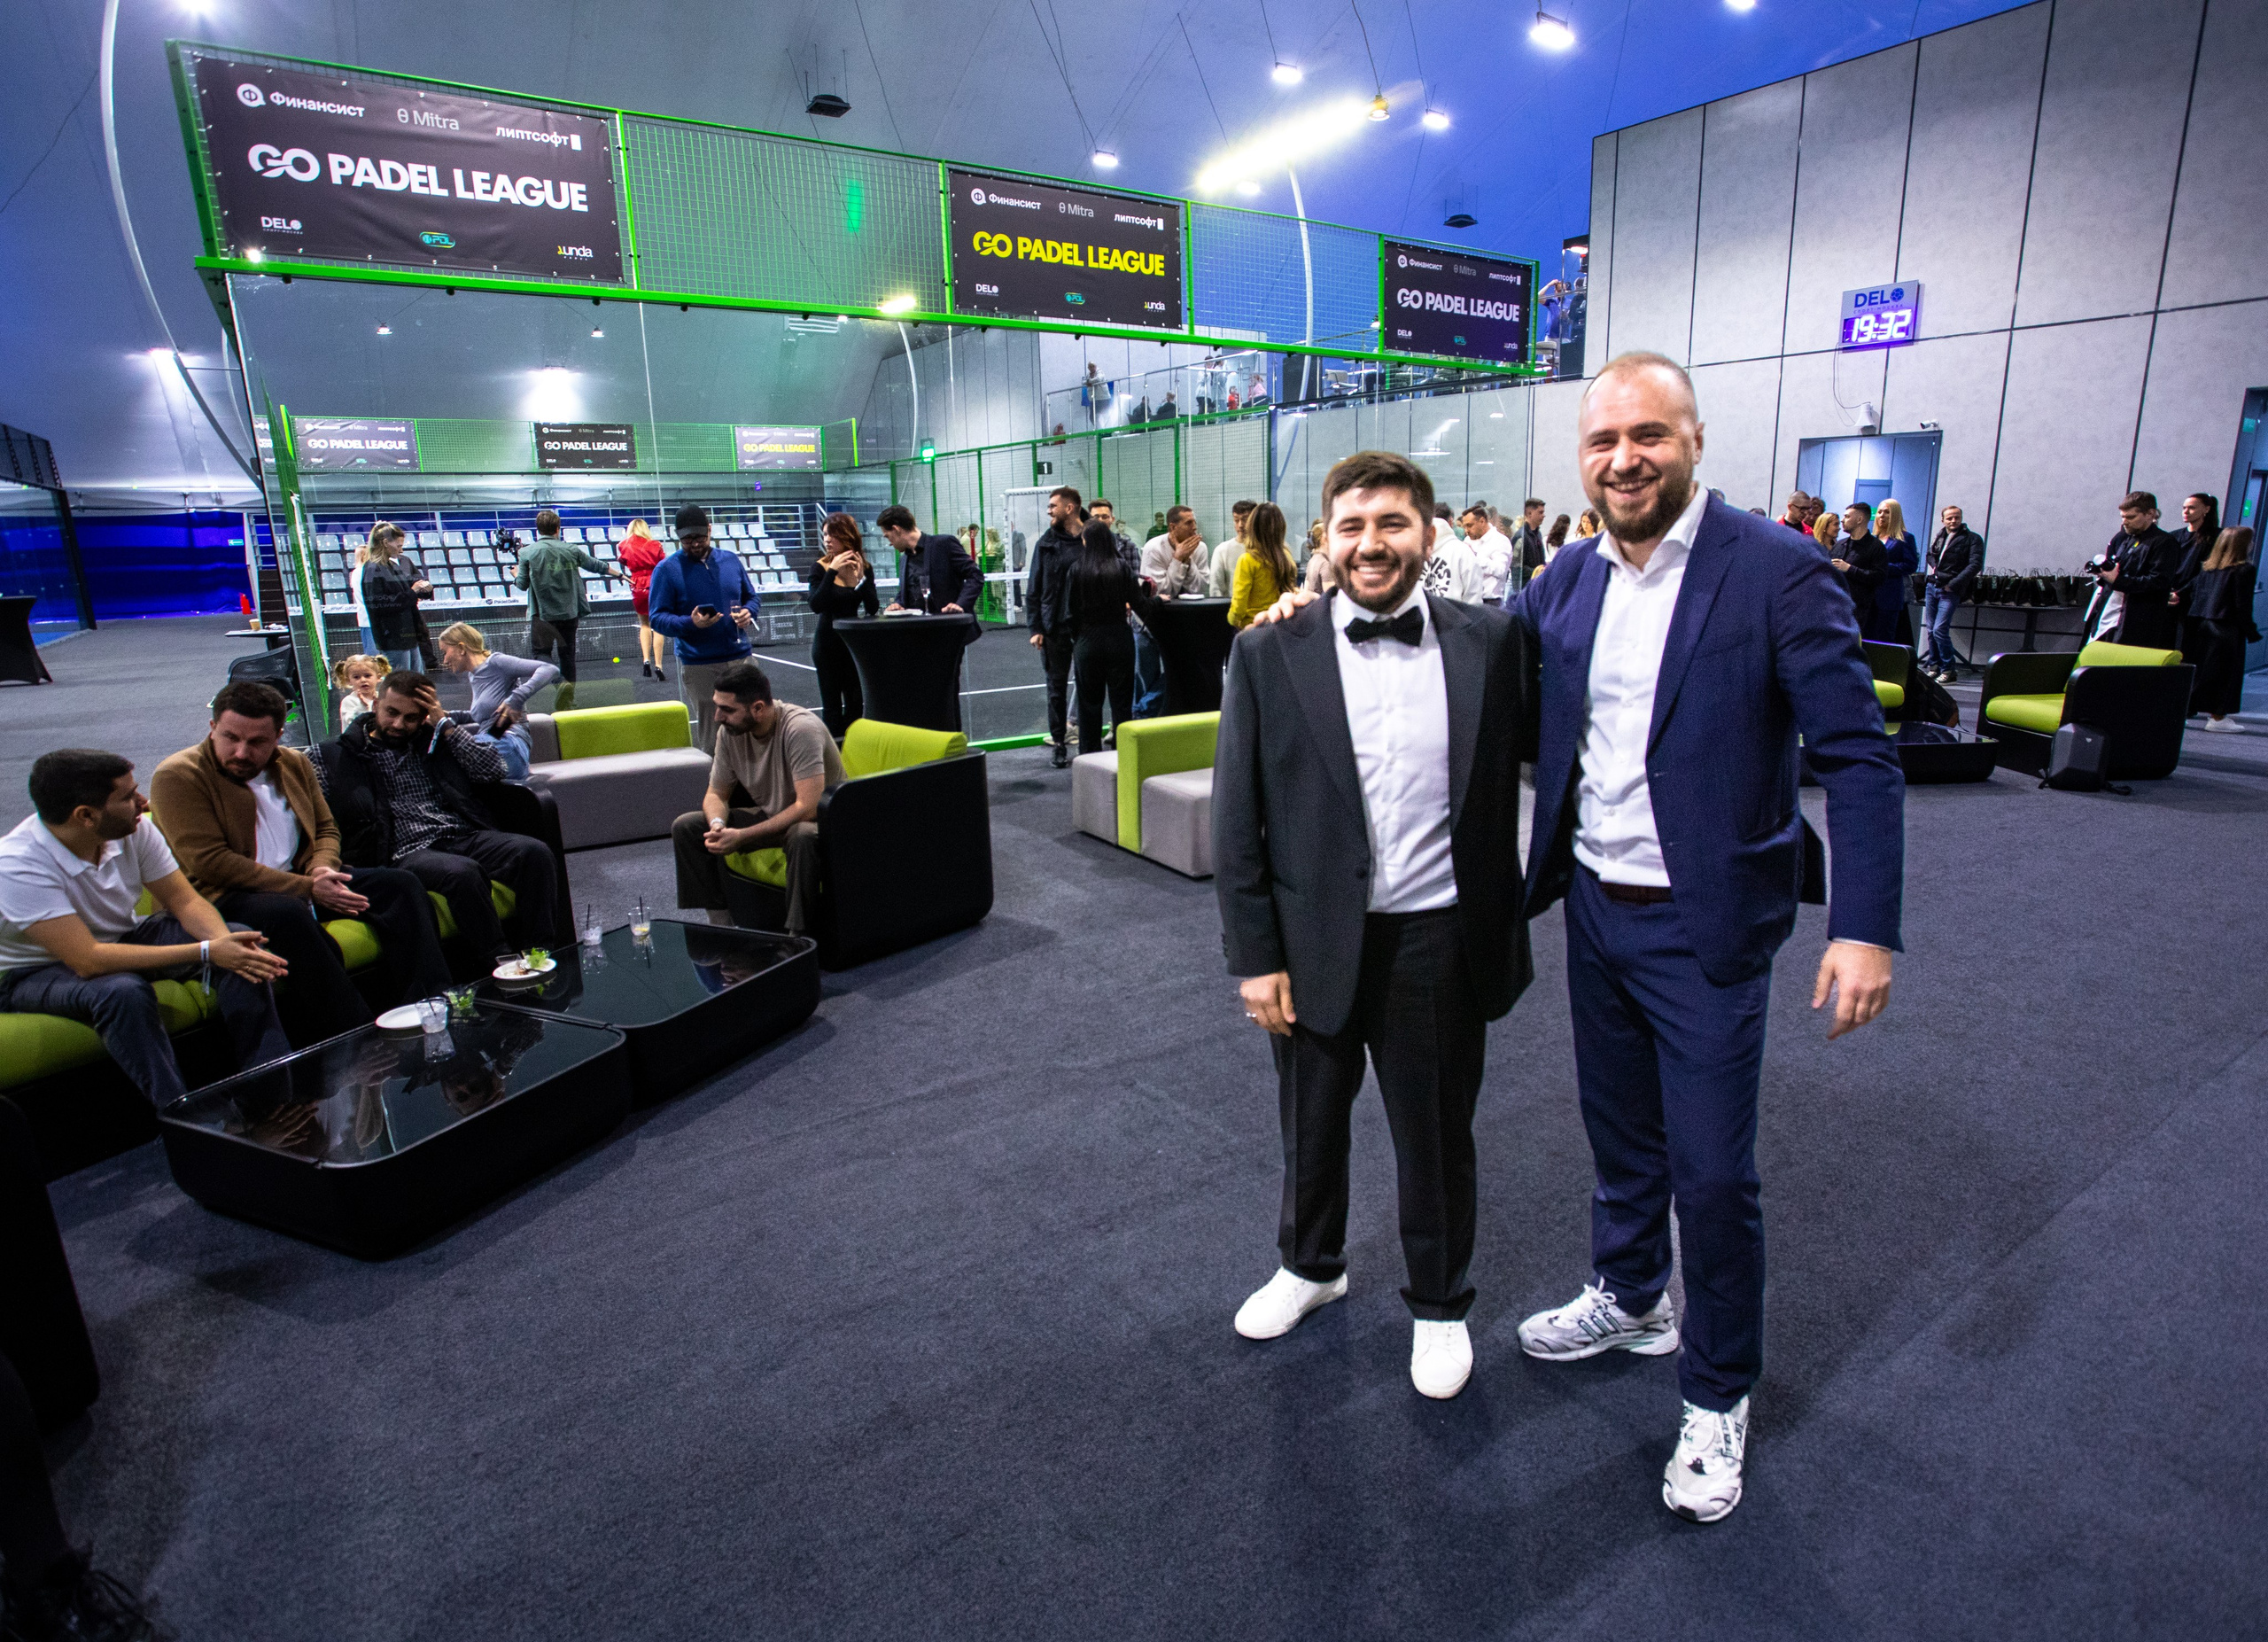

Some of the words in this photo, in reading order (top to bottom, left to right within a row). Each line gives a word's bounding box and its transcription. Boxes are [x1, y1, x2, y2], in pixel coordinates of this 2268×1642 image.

[269, 91, 365, 118] Финансист
[413, 110, 460, 131] Mitra
[495, 126, 569, 148] липтсофт
[247, 144, 321, 183] GO
[328, 152, 448, 198] PADEL
[454, 167, 589, 213] LEAGUE
[989, 193, 1041, 211] Финансист
[1068, 203, 1094, 218] Mitra
[1114, 214, 1157, 229] липтсофт
[973, 230, 1014, 259] GO
[1017, 236, 1084, 268] PADEL
[1087, 245, 1165, 276] LEAGUE
[1397, 287, 1423, 309] GO
[1425, 292, 1468, 315] PADEL
[1470, 298, 1520, 323] LEAGUE
[1852, 308, 1912, 343] 19:32
[307, 439, 329, 449] GO
[330, 440, 364, 450] PADEL
[366, 440, 408, 450] LEAGUE
[544, 440, 561, 450] GO
[562, 441, 592, 451] PADEL
[592, 442, 628, 451] LEAGUE
[743, 443, 758, 452] GO
[758, 443, 784, 453] PADEL
[784, 444, 816, 453] LEAGUE
[1043, 463, 1048, 474] 1
